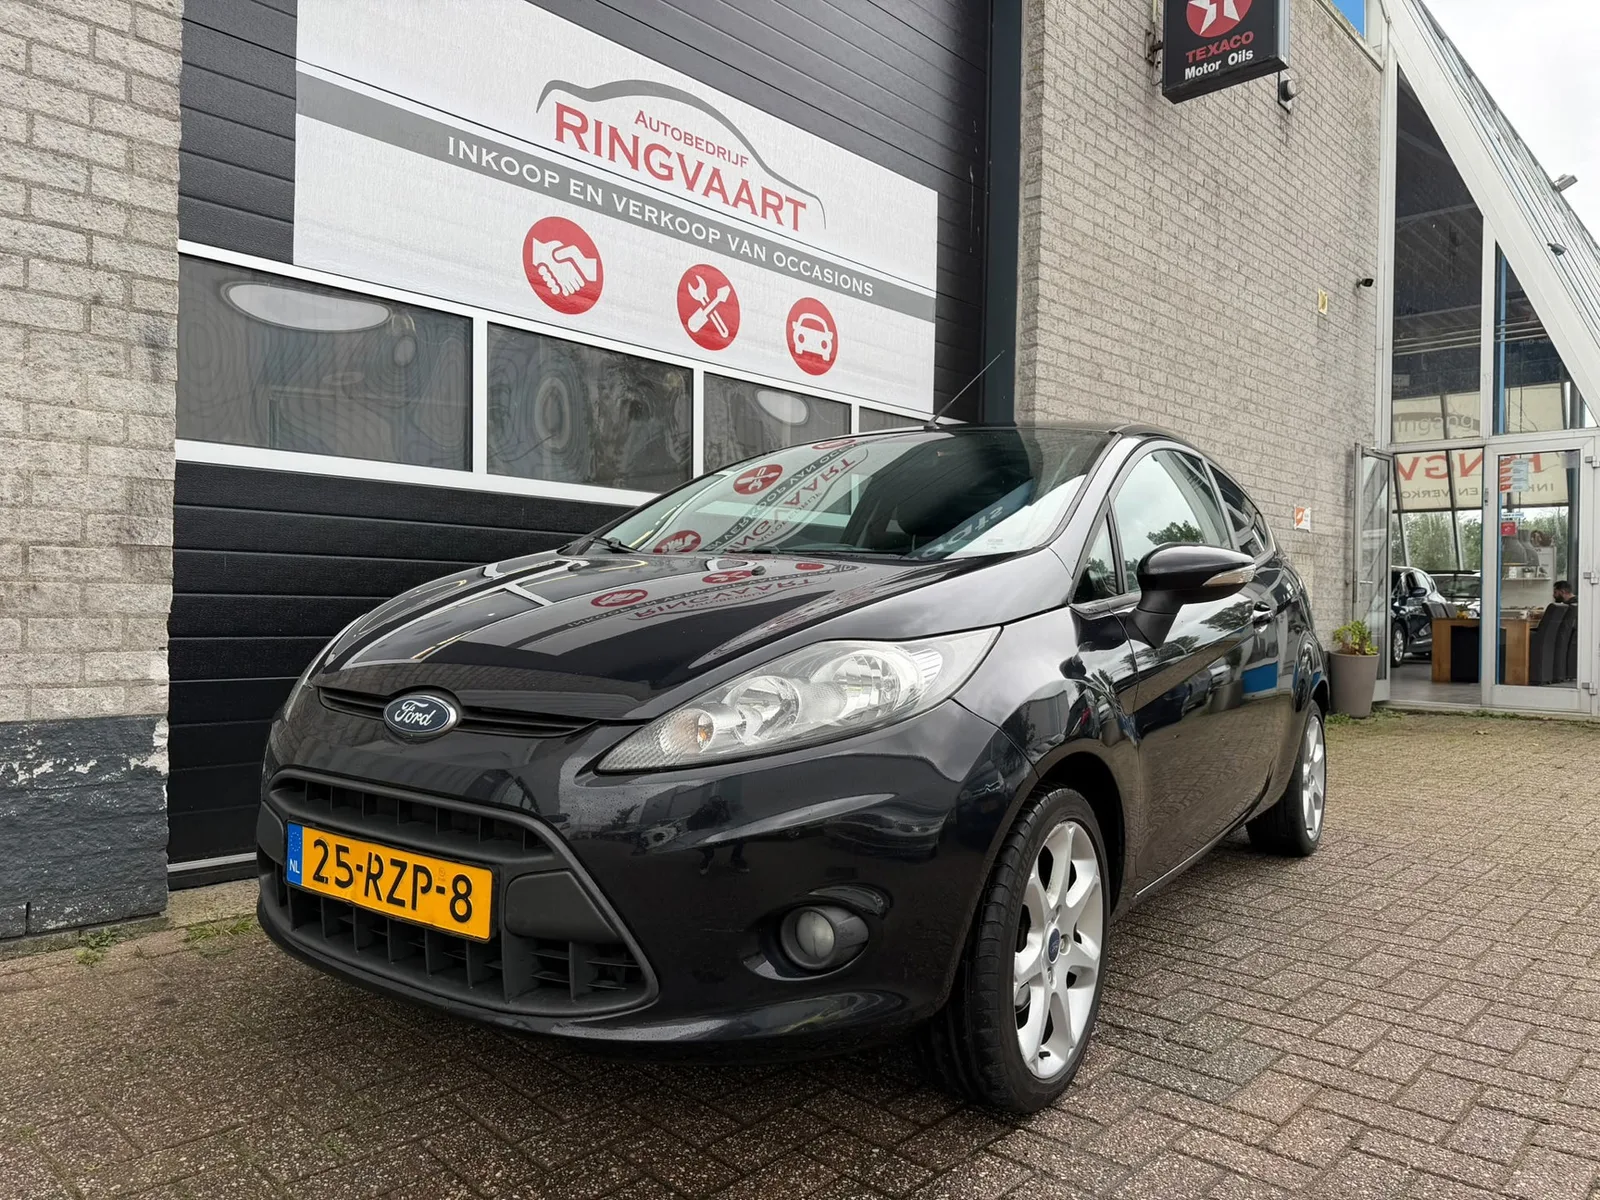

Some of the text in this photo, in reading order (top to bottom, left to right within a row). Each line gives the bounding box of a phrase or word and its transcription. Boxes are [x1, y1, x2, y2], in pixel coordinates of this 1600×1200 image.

[1185, 49, 1254, 80] Motor Oils
[1186, 31, 1254, 63] TEXACO
[634, 110, 749, 168] AUTOBEDRIJF
[555, 102, 807, 232] RINGVAART
[448, 136, 874, 297] INKOOP EN VERKOOP VAN OCCASIONS
[394, 700, 436, 726] Ford
[289, 857, 301, 874] NL
[313, 838, 473, 923] 25-RZP-8
